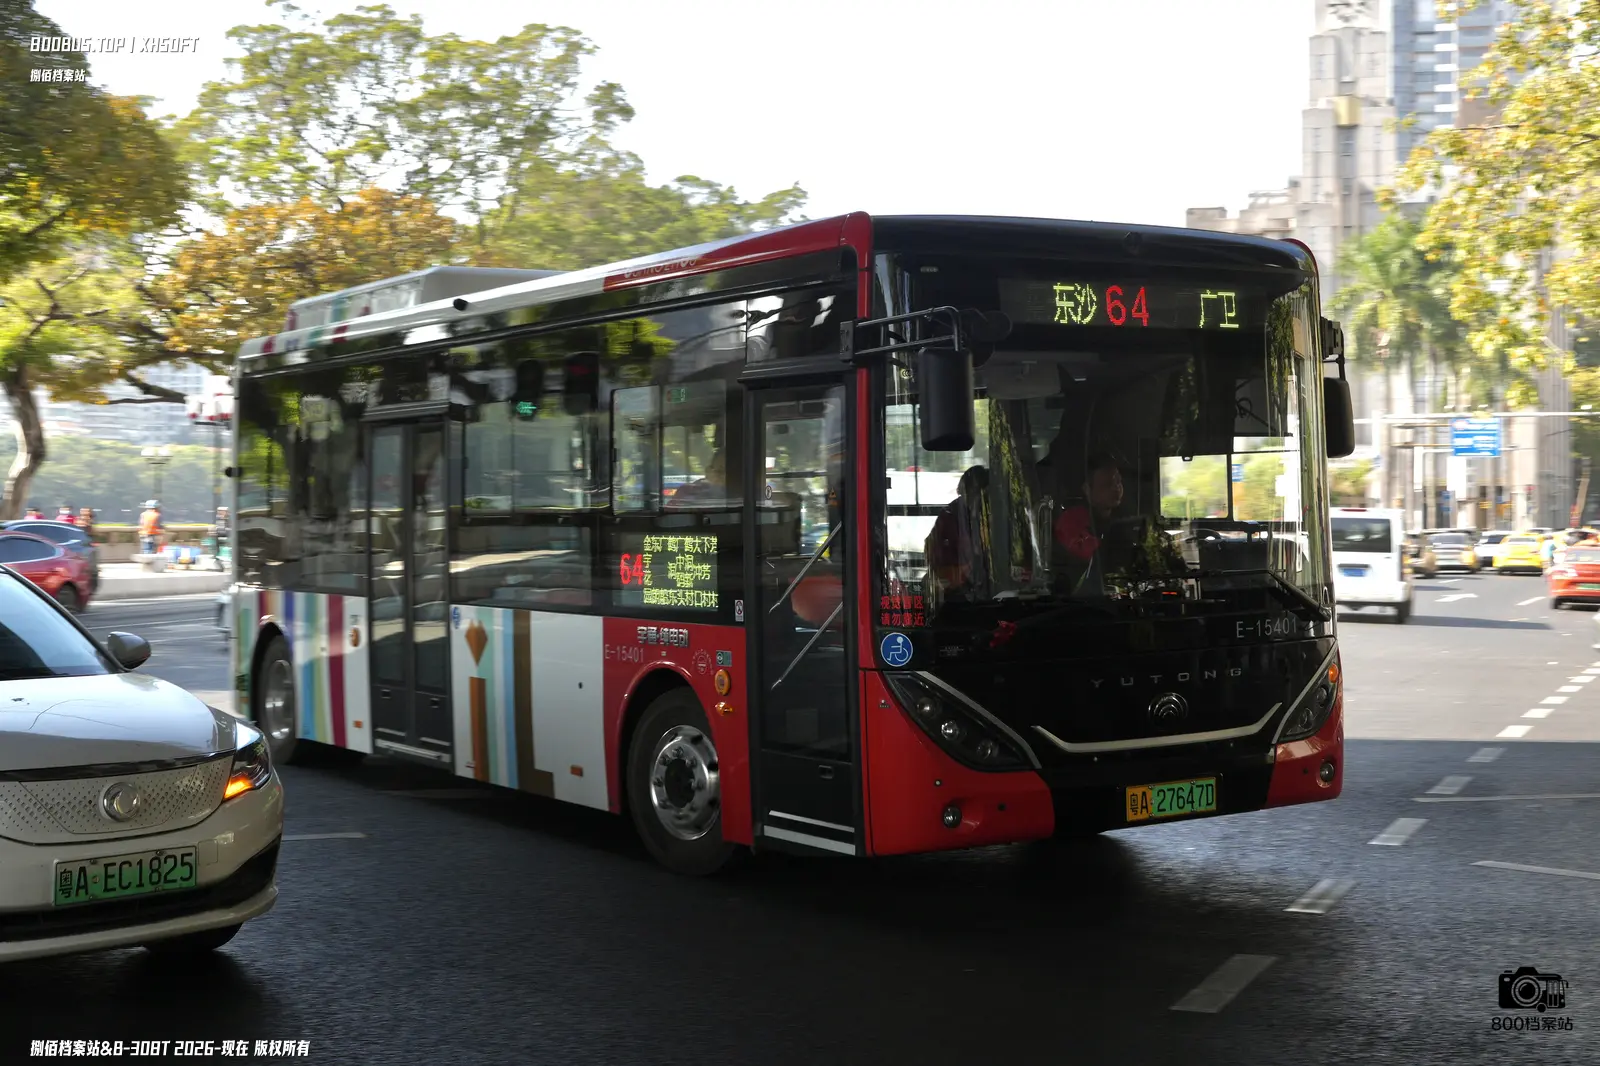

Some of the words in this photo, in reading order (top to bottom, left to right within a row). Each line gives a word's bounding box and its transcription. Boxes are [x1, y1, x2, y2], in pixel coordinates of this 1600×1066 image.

[1053, 283, 1098, 324] 东沙
[1105, 285, 1150, 327] 64
[620, 553, 644, 585] 64
[1236, 617, 1298, 638] E-15401
[605, 644, 644, 662] E-15401
[1091, 667, 1242, 688] YUTONG
